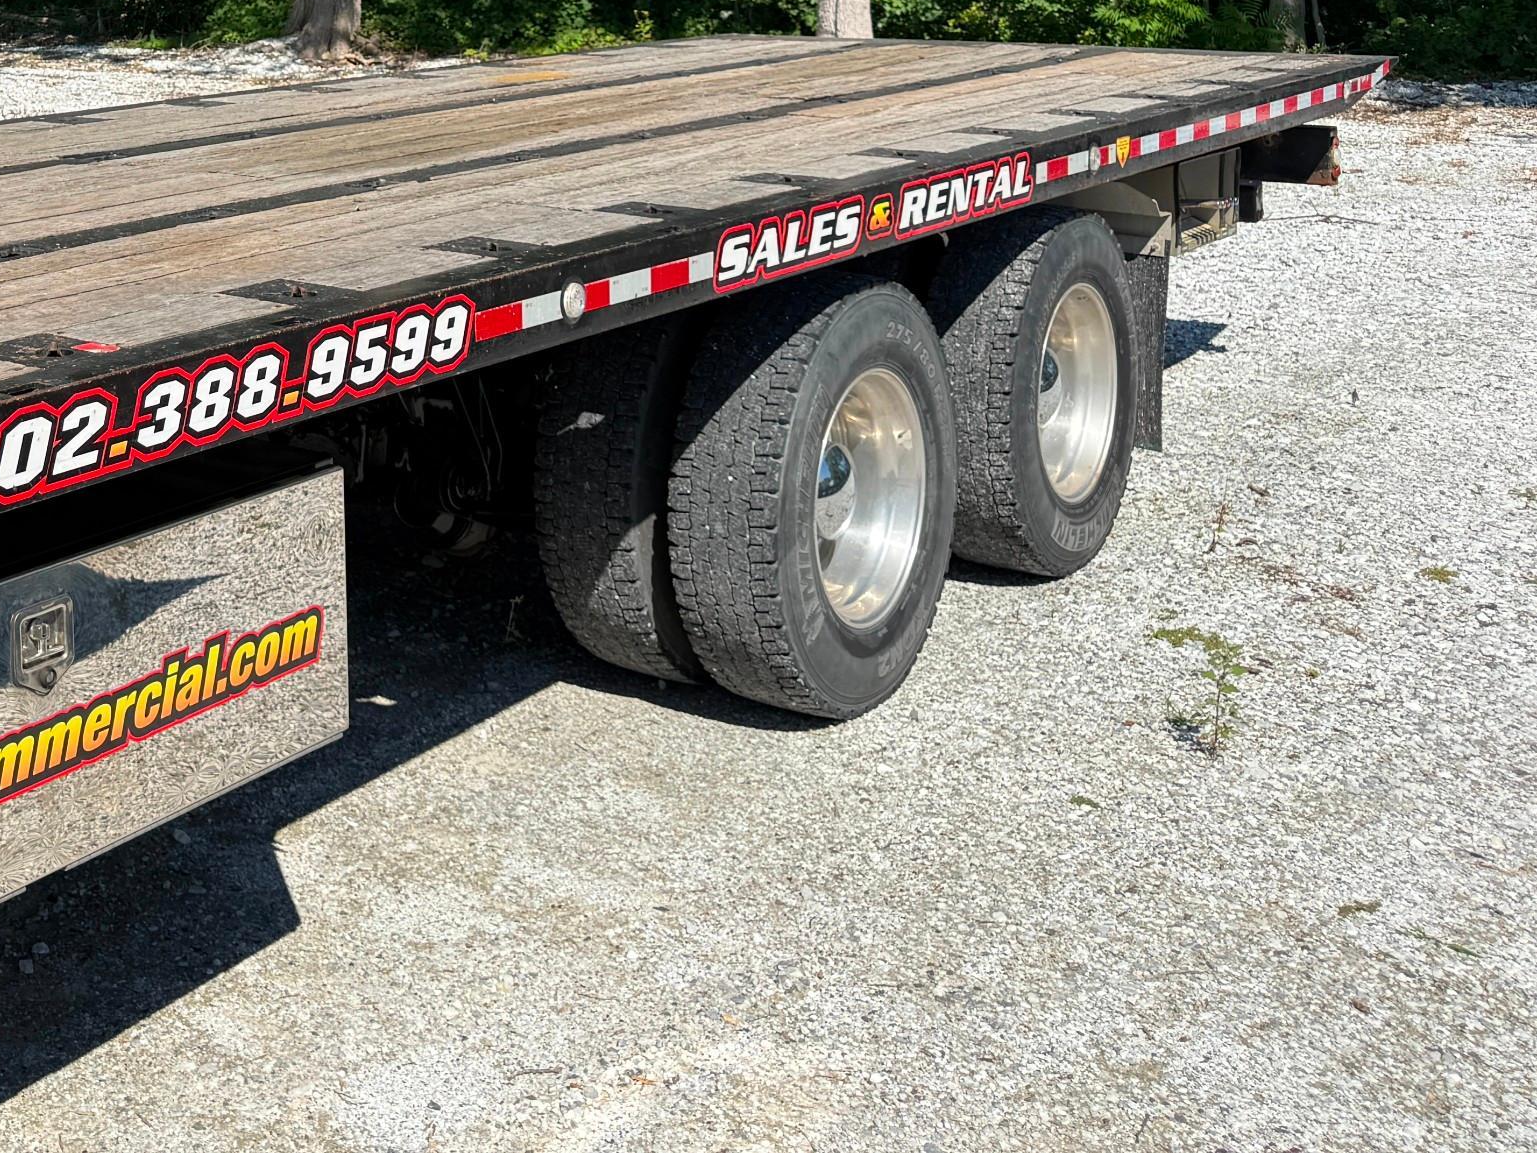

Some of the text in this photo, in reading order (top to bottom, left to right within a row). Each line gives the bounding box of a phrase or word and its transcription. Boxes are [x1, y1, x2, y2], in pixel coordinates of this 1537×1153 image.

[718, 160, 1032, 282] SALES & RENTAL
